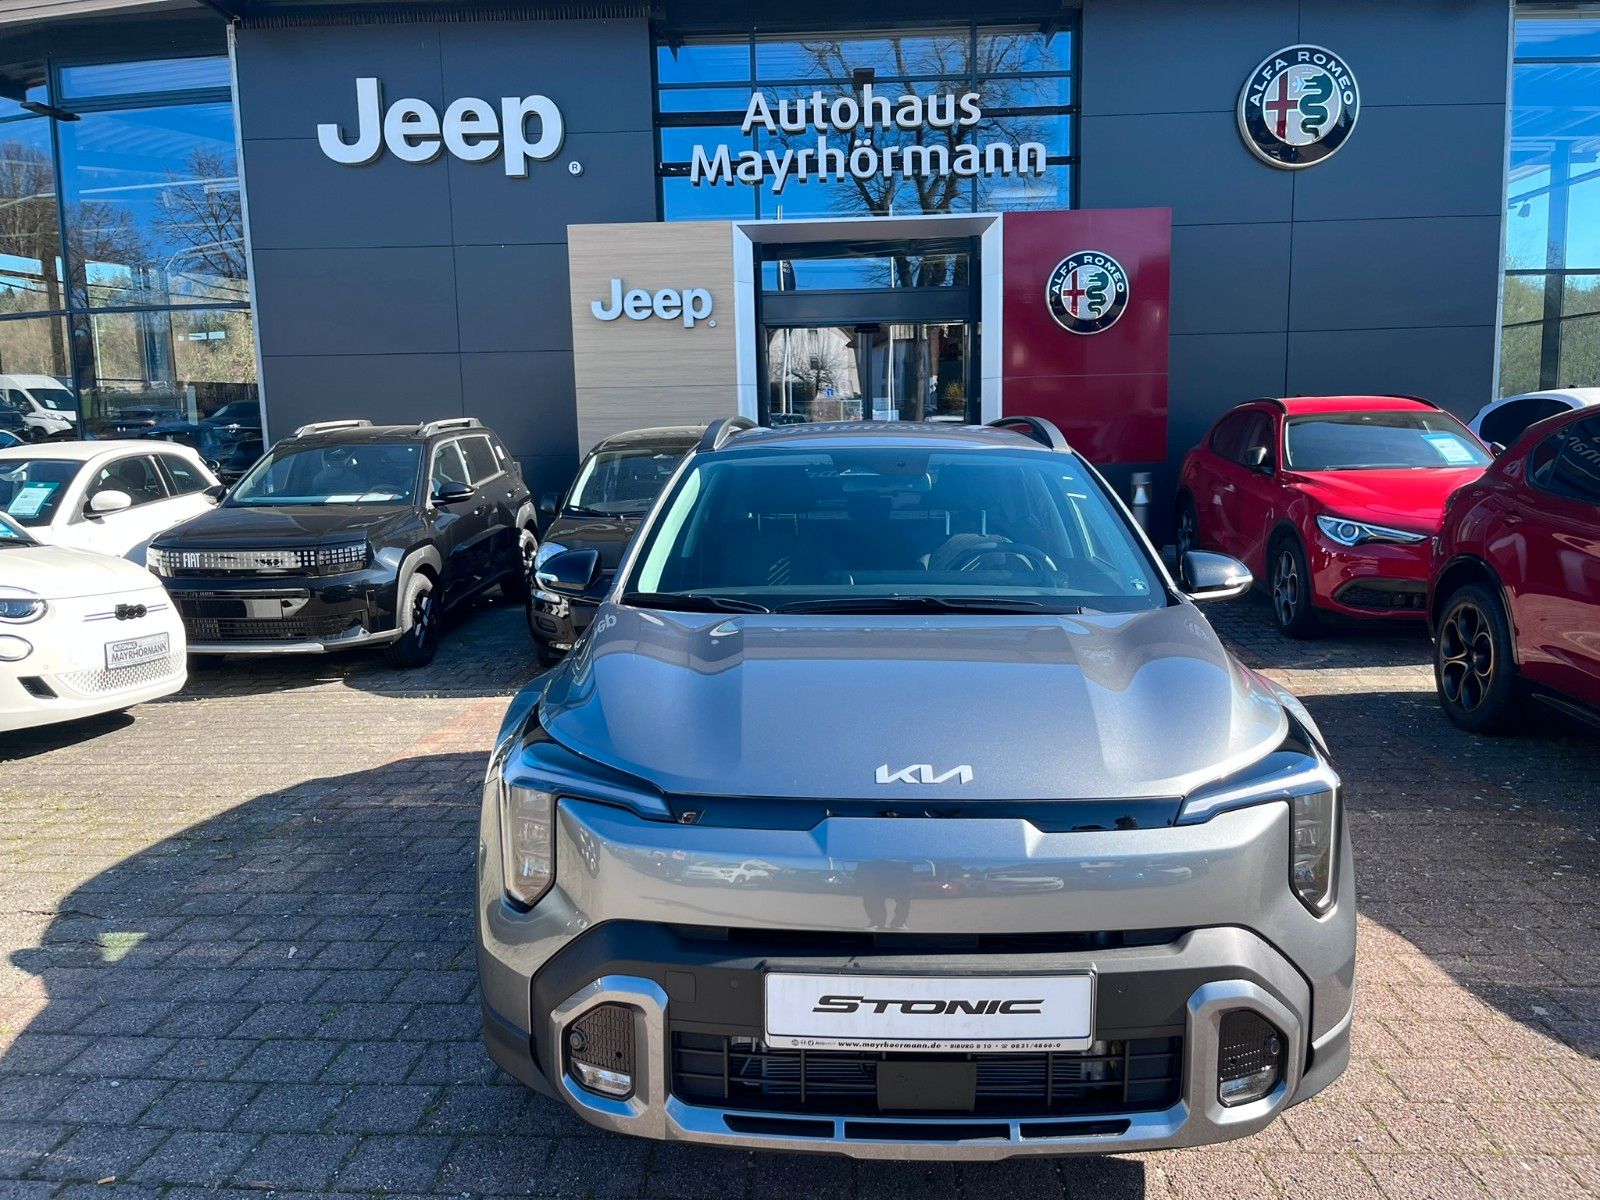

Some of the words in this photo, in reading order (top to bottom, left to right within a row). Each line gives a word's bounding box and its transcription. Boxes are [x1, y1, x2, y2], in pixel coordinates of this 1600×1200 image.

[1249, 58, 1289, 107] ALFA
[1297, 51, 1354, 106] ROMEO
[317, 77, 563, 177] Jeep
[741, 83, 982, 134] Autohaus
[690, 136, 1047, 193] Mayrhörmann
[1051, 260, 1078, 295] ALFA
[1083, 255, 1125, 293] ROMEO
[591, 277, 713, 329] Jeep
[182, 552, 200, 568] FIAT
[115, 603, 147, 621] 500
[875, 764, 973, 784] KIA
[812, 995, 1045, 1015] STONIC
[838, 1041, 941, 1050] www.mayrhoermann.de
